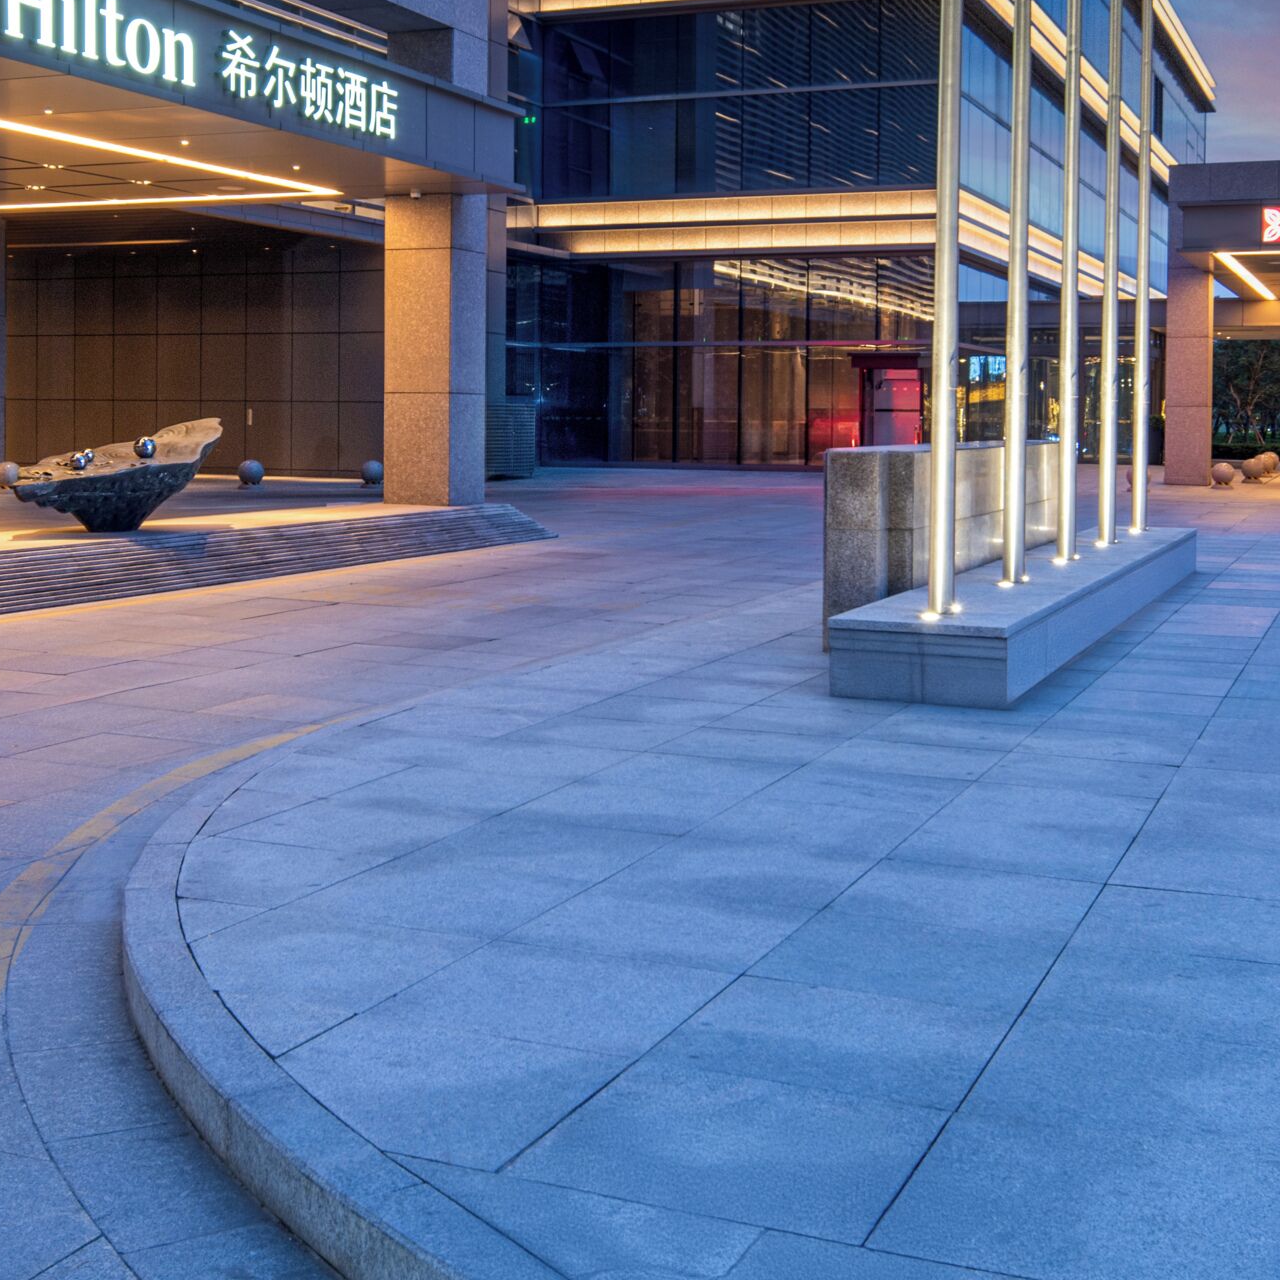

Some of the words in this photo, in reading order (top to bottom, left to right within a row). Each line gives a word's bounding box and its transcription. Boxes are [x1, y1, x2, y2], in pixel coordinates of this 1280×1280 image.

[222, 29, 398, 139] 希尔顿酒店
